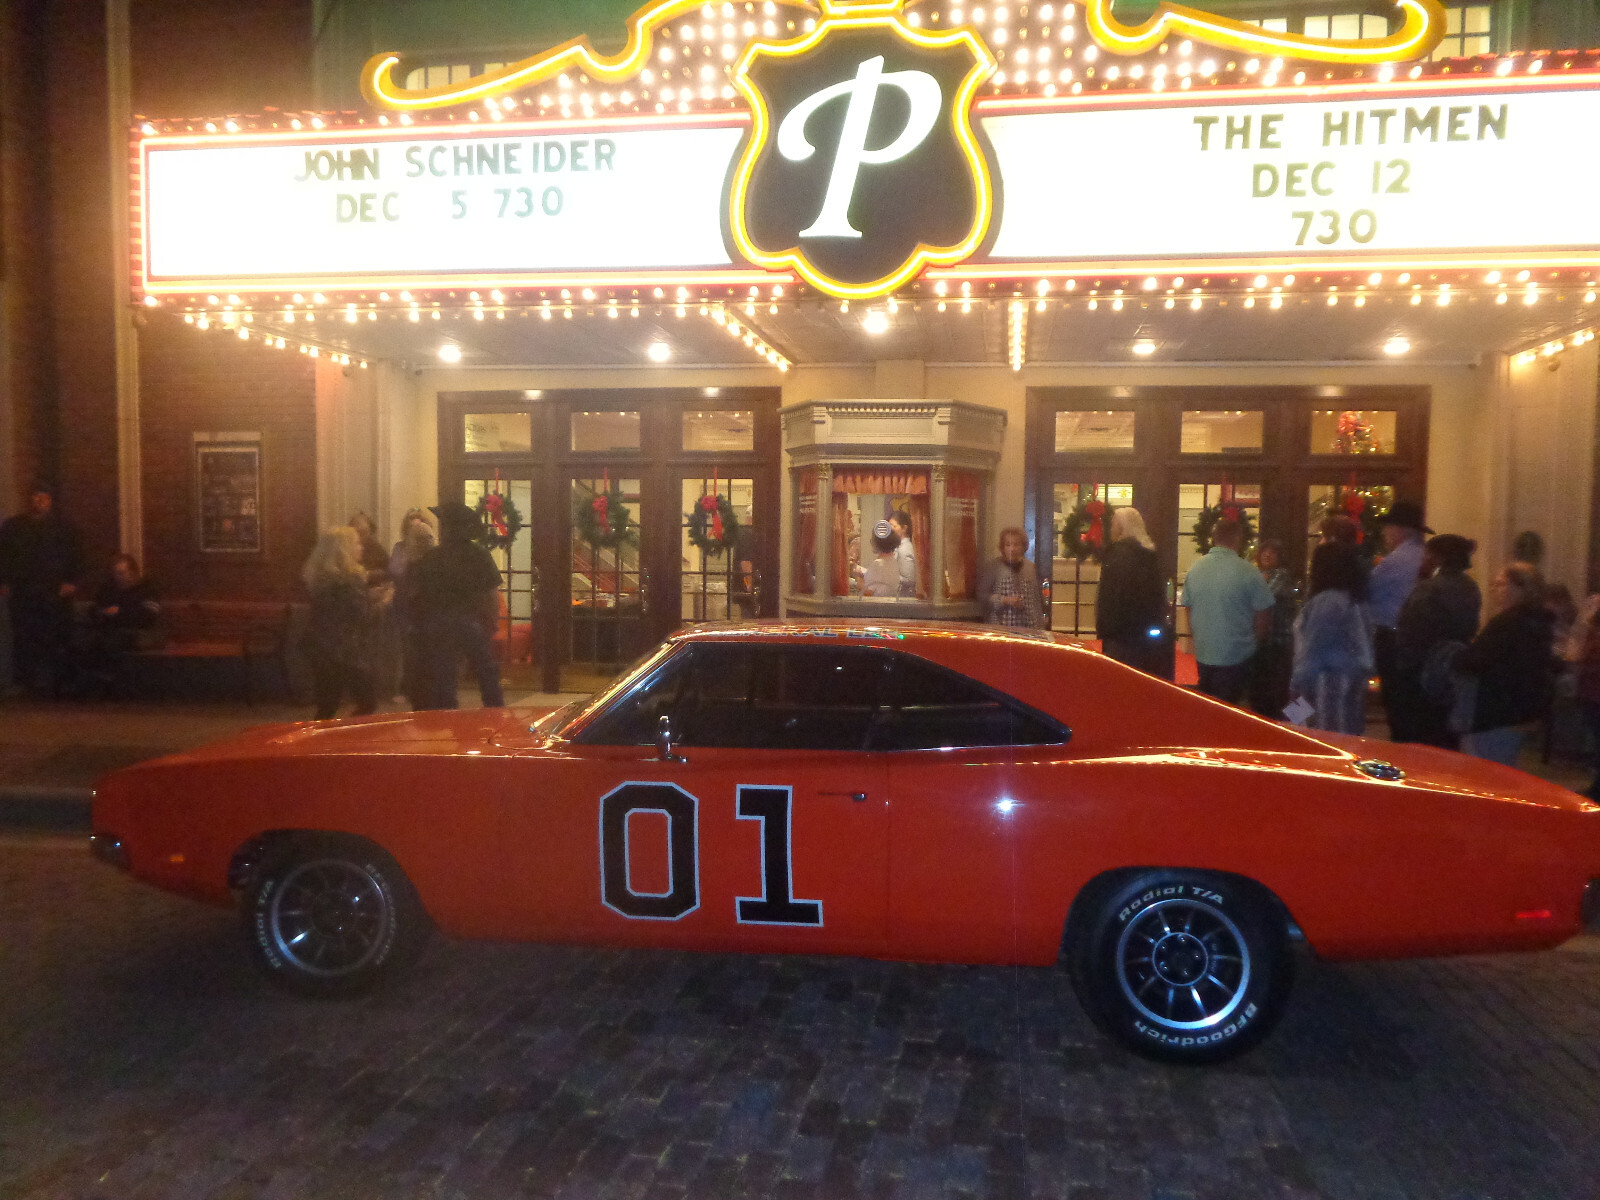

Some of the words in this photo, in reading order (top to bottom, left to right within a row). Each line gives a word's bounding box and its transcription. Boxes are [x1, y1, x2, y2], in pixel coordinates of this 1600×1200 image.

[777, 55, 942, 237] P
[1193, 113, 1284, 151] THE
[1322, 104, 1508, 147] HITMEN
[294, 148, 380, 181] JOHN
[405, 138, 617, 178] SCHNEIDER
[1252, 161, 1336, 198] DEC
[1372, 158, 1411, 194] 12
[336, 192, 400, 223] DEC
[451, 190, 467, 219] 5
[494, 186, 564, 218] 730
[1291, 208, 1377, 246] 730
[599, 780, 823, 927] 01
[1119, 885, 1184, 922] Radial
[1192, 886, 1225, 905] T/A
